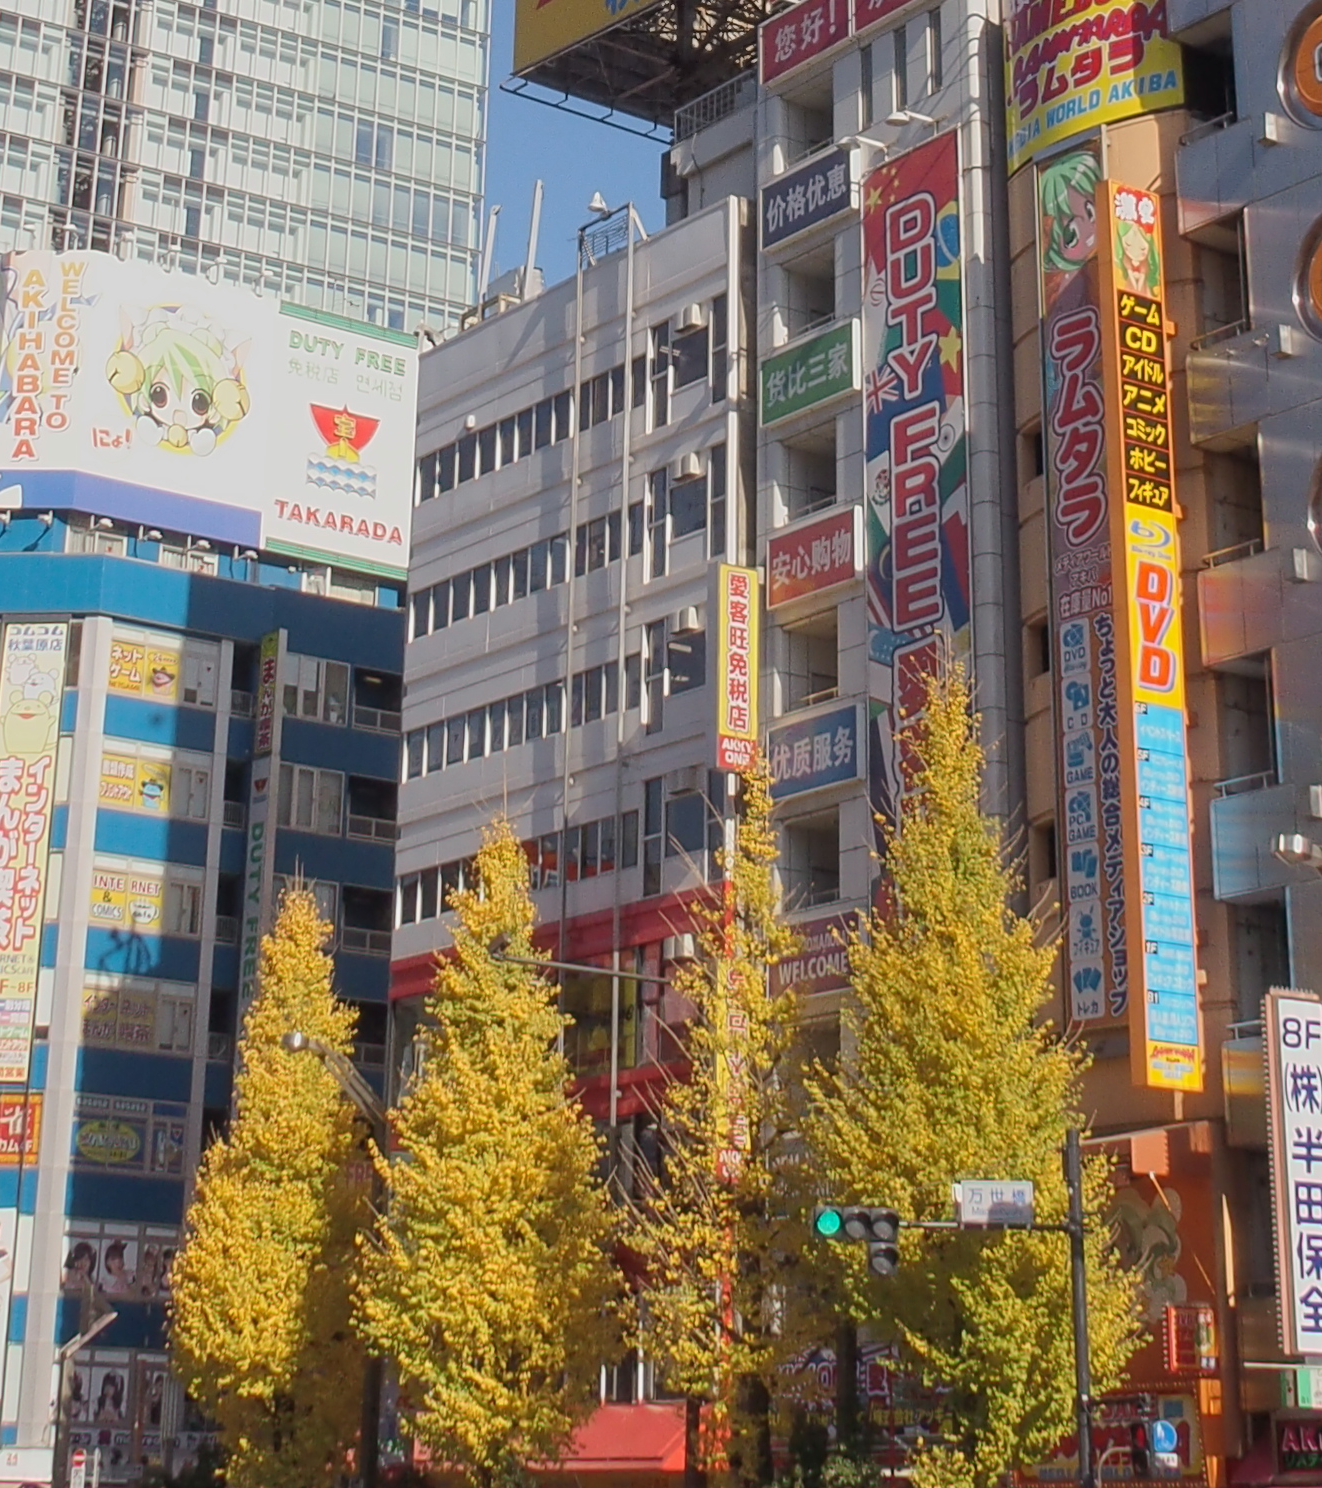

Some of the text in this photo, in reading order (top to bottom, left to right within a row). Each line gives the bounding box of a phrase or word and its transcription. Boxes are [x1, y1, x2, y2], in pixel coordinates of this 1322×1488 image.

[1020, 34, 1145, 121] ラムタラ
[1046, 88, 1101, 130] WORLD
[1108, 68, 1177, 104] AKIBA
[885, 192, 938, 401] DUTY
[1120, 294, 1161, 327] ゲーム
[45, 260, 89, 432] WELCOME TO
[288, 330, 407, 378] DUTY FREE
[1125, 327, 1157, 354] CD
[10, 267, 46, 462] AKIHABARA
[1122, 353, 1164, 386] アイドル
[1123, 384, 1166, 415] アニメ
[1051, 305, 1109, 549] ラムタラ
[1126, 417, 1167, 446] コミック
[1129, 446, 1167, 474] ホビー
[1128, 478, 1169, 507] フィギュア
[274, 498, 404, 546] TAKARADA
[890, 400, 945, 634] FREE
[9, 625, 64, 637] コムコム
[1136, 560, 1176, 693] DVD
[8, 639, 63, 652] 秋葉原店
[111, 645, 143, 661] ネット
[728, 572, 750, 733] 愛客旺免税店
[1064, 646, 1086, 661] DVD
[109, 664, 142, 684] ゲーム
[1066, 766, 1094, 785] GAME
[1068, 813, 1084, 827] PC
[1068, 826, 1096, 843] GAME
[13, 755, 52, 949] インターネット
[243, 821, 267, 901] DUTY
[1070, 882, 1098, 899] BOOK
[92, 903, 123, 920] COMICS
[1146, 941, 1158, 954] 1F
[779, 952, 848, 987] WELCOME
[1077, 1000, 1099, 1016] トレカ
[1282, 1017, 1321, 1050] 8F
[967, 1187, 1027, 1206] 万世橋
